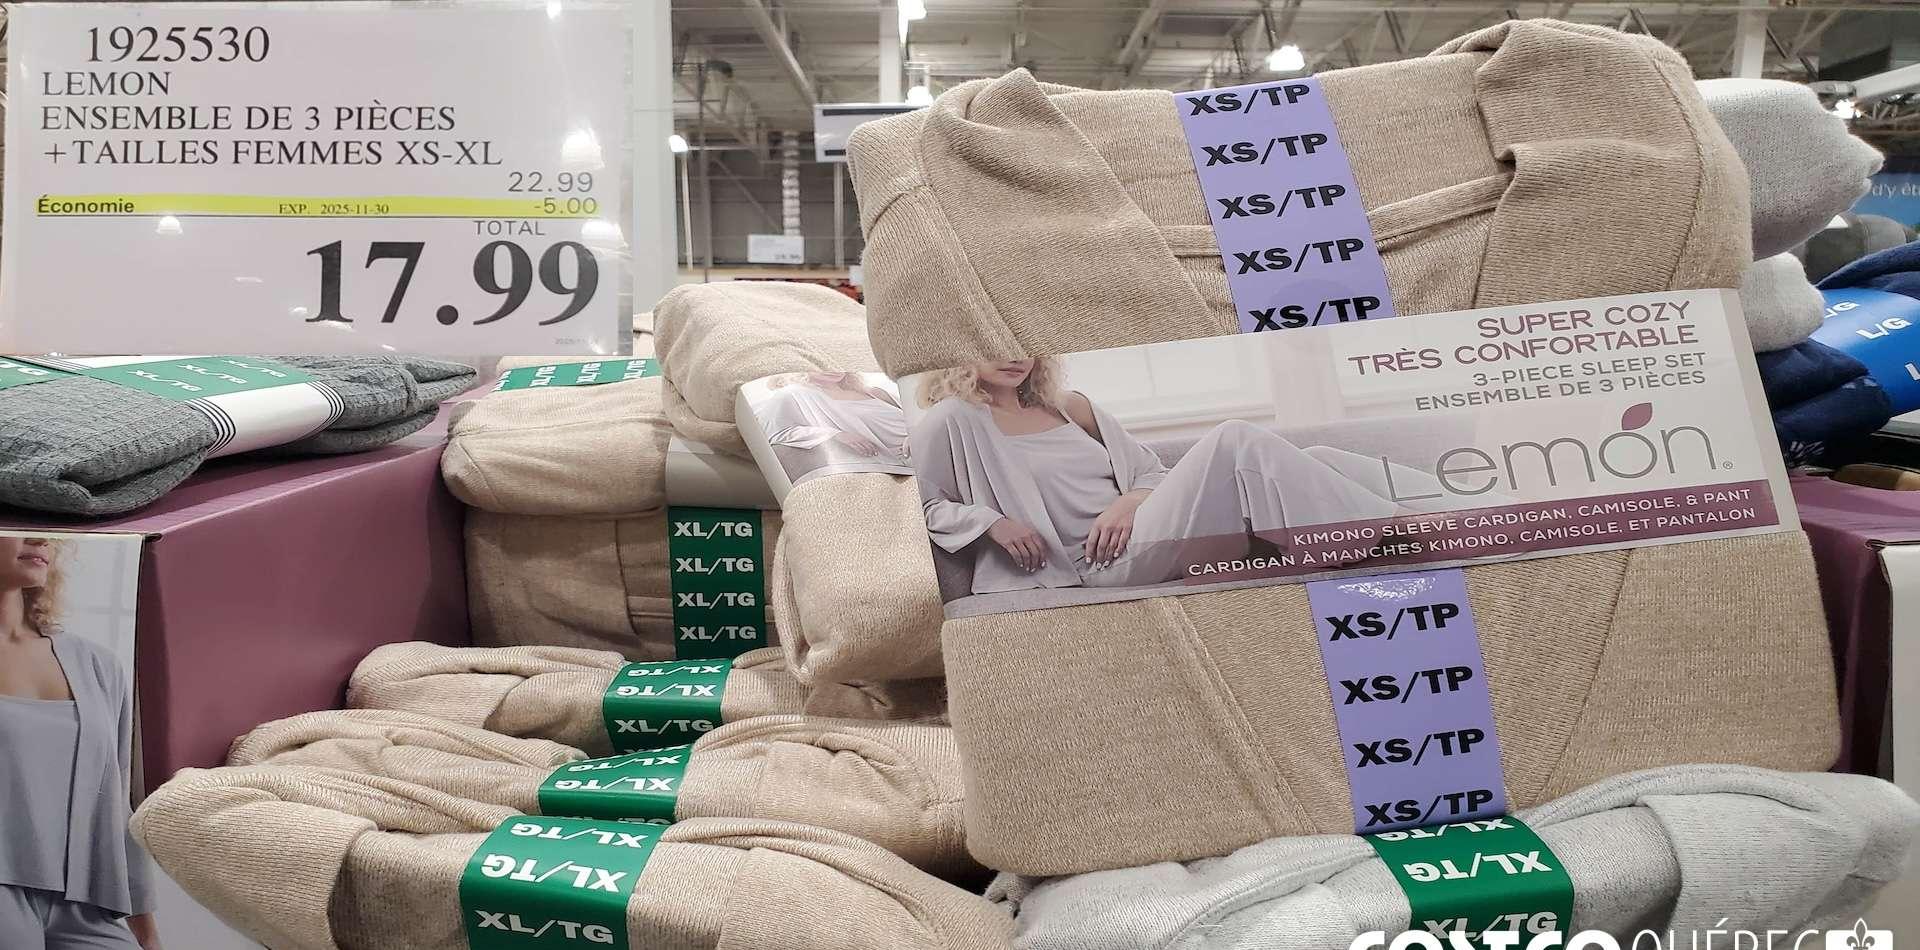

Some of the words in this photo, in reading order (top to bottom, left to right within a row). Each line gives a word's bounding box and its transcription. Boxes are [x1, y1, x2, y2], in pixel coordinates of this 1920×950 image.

[87, 26, 270, 62] 1925530
[43, 71, 172, 96] LEMON
[40, 105, 232, 130] ENSEMBLE
[245, 106, 292, 130] DE
[305, 106, 320, 131] 3
[335, 99, 455, 131] PIÈCES
[1186, 84, 1310, 116] XS/TP
[44, 140, 218, 164] +TAILLES
[232, 140, 382, 165] FEMMES
[395, 140, 503, 165] XS-XL
[1201, 133, 1328, 167] XS/TP
[508, 171, 593, 192] 22.99
[38, 194, 135, 213] Économie
[278, 203, 311, 215] EXP.
[320, 203, 389, 215] 2025-11-30
[534, 197, 598, 214] -5.00
[1216, 184, 1346, 219] XS/TP
[473, 220, 546, 236] TOTAL
[1233, 238, 1364, 275] XS/TP
[304, 239, 599, 326] 17.99
[1249, 296, 1381, 333] XS/TP
[1477, 309, 1593, 338] SUPER
[1605, 300, 1690, 326] COZY
[1856, 317, 1912, 339] L/G
[1348, 347, 1443, 375] TRÈS
[1454, 324, 1699, 365] CONFORTABLE
[1473, 365, 1574, 387] 3-PIECE
[1582, 356, 1657, 376] SLEEP
[1665, 352, 1706, 368] SET
[1415, 384, 1552, 411] ENSEMBLE
[1560, 381, 1591, 397] DE
[1600, 379, 1614, 393] 3
[1622, 371, 1706, 391] PIÈCES
[674, 522, 753, 539] XL/TG
[1293, 527, 1375, 546] KIMONO
[1382, 518, 1458, 538] SLEEVE
[1464, 507, 1572, 529] CARDIGAN,
[1577, 496, 1681, 517] CAMISOLE,
[1686, 494, 1698, 506] &
[1704, 488, 1751, 504] PANT
[1189, 554, 1296, 576] CARDIGAN
[1302, 550, 1317, 565] À
[1322, 542, 1423, 563] MANCHES
[1429, 532, 1514, 552] KIMONO,
[1519, 521, 1623, 542] CAMISOLE,
[1629, 518, 1651, 532] ET
[1657, 507, 1756, 528] PANTALON
[675, 557, 754, 575] XL/TG
[677, 592, 756, 609] XL/TG
[679, 626, 757, 642] XL/TG
[1325, 603, 1460, 641] XS/TP
[628, 665, 725, 677] XL/TG
[1339, 666, 1473, 705] XS/TP
[616, 683, 717, 697] XL/TG
[614, 719, 714, 735] XL/TG
[567, 754, 682, 772] XL/TG
[1353, 728, 1485, 768] XS/TP
[555, 776, 677, 792] XL/TG
[1364, 789, 1494, 827] XS/TP
[510, 822, 649, 849] XL/TG
[480, 853, 628, 893] XL/TG
[1402, 851, 1552, 882] XL/TG
[474, 909, 614, 945] XL/TG
[1423, 911, 1558, 942] XL/TG
